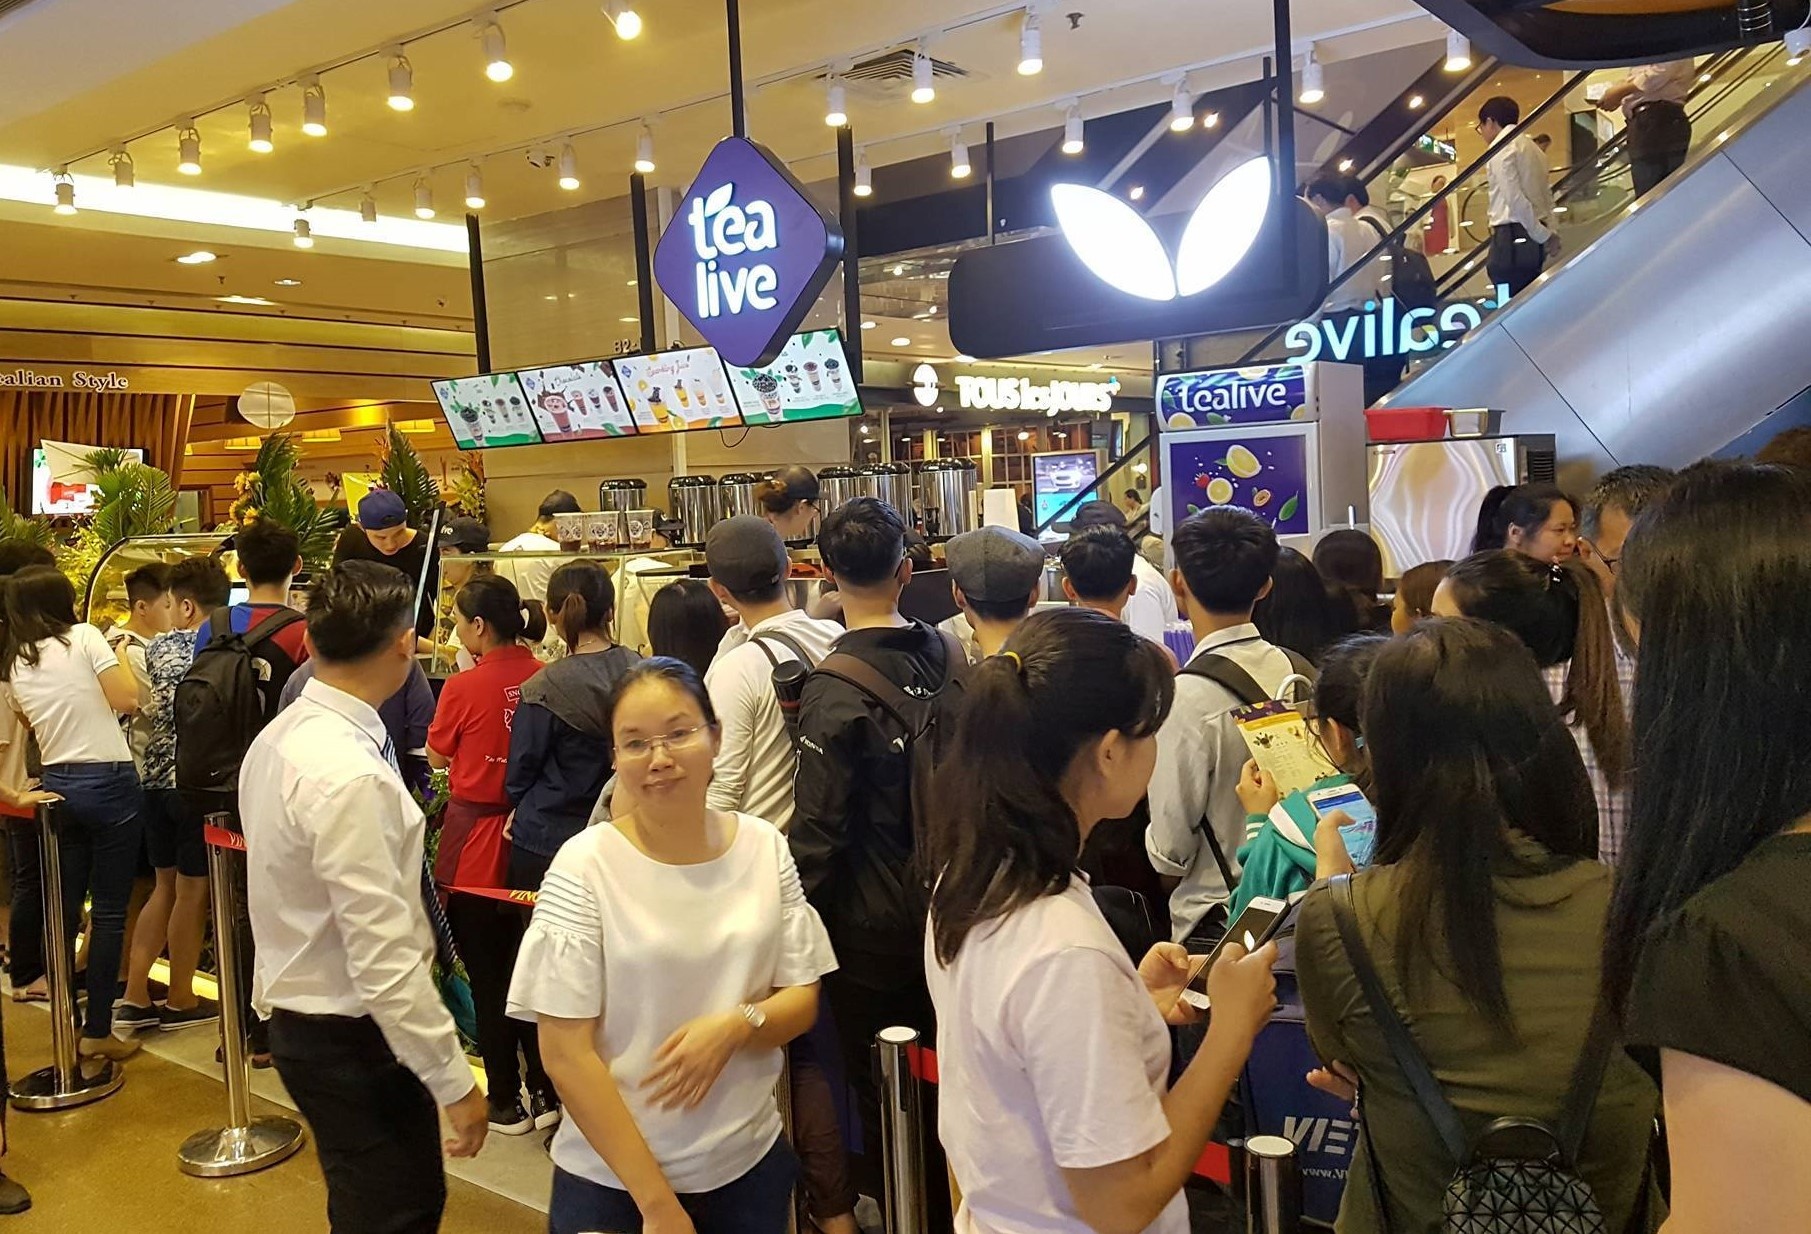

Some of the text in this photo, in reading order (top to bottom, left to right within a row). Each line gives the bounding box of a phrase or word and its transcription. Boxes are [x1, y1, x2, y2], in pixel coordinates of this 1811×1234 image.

[688, 194, 778, 260] tea
[696, 260, 778, 319] live
[72, 371, 128, 393] Style
[1178, 381, 1287, 413] tealive
